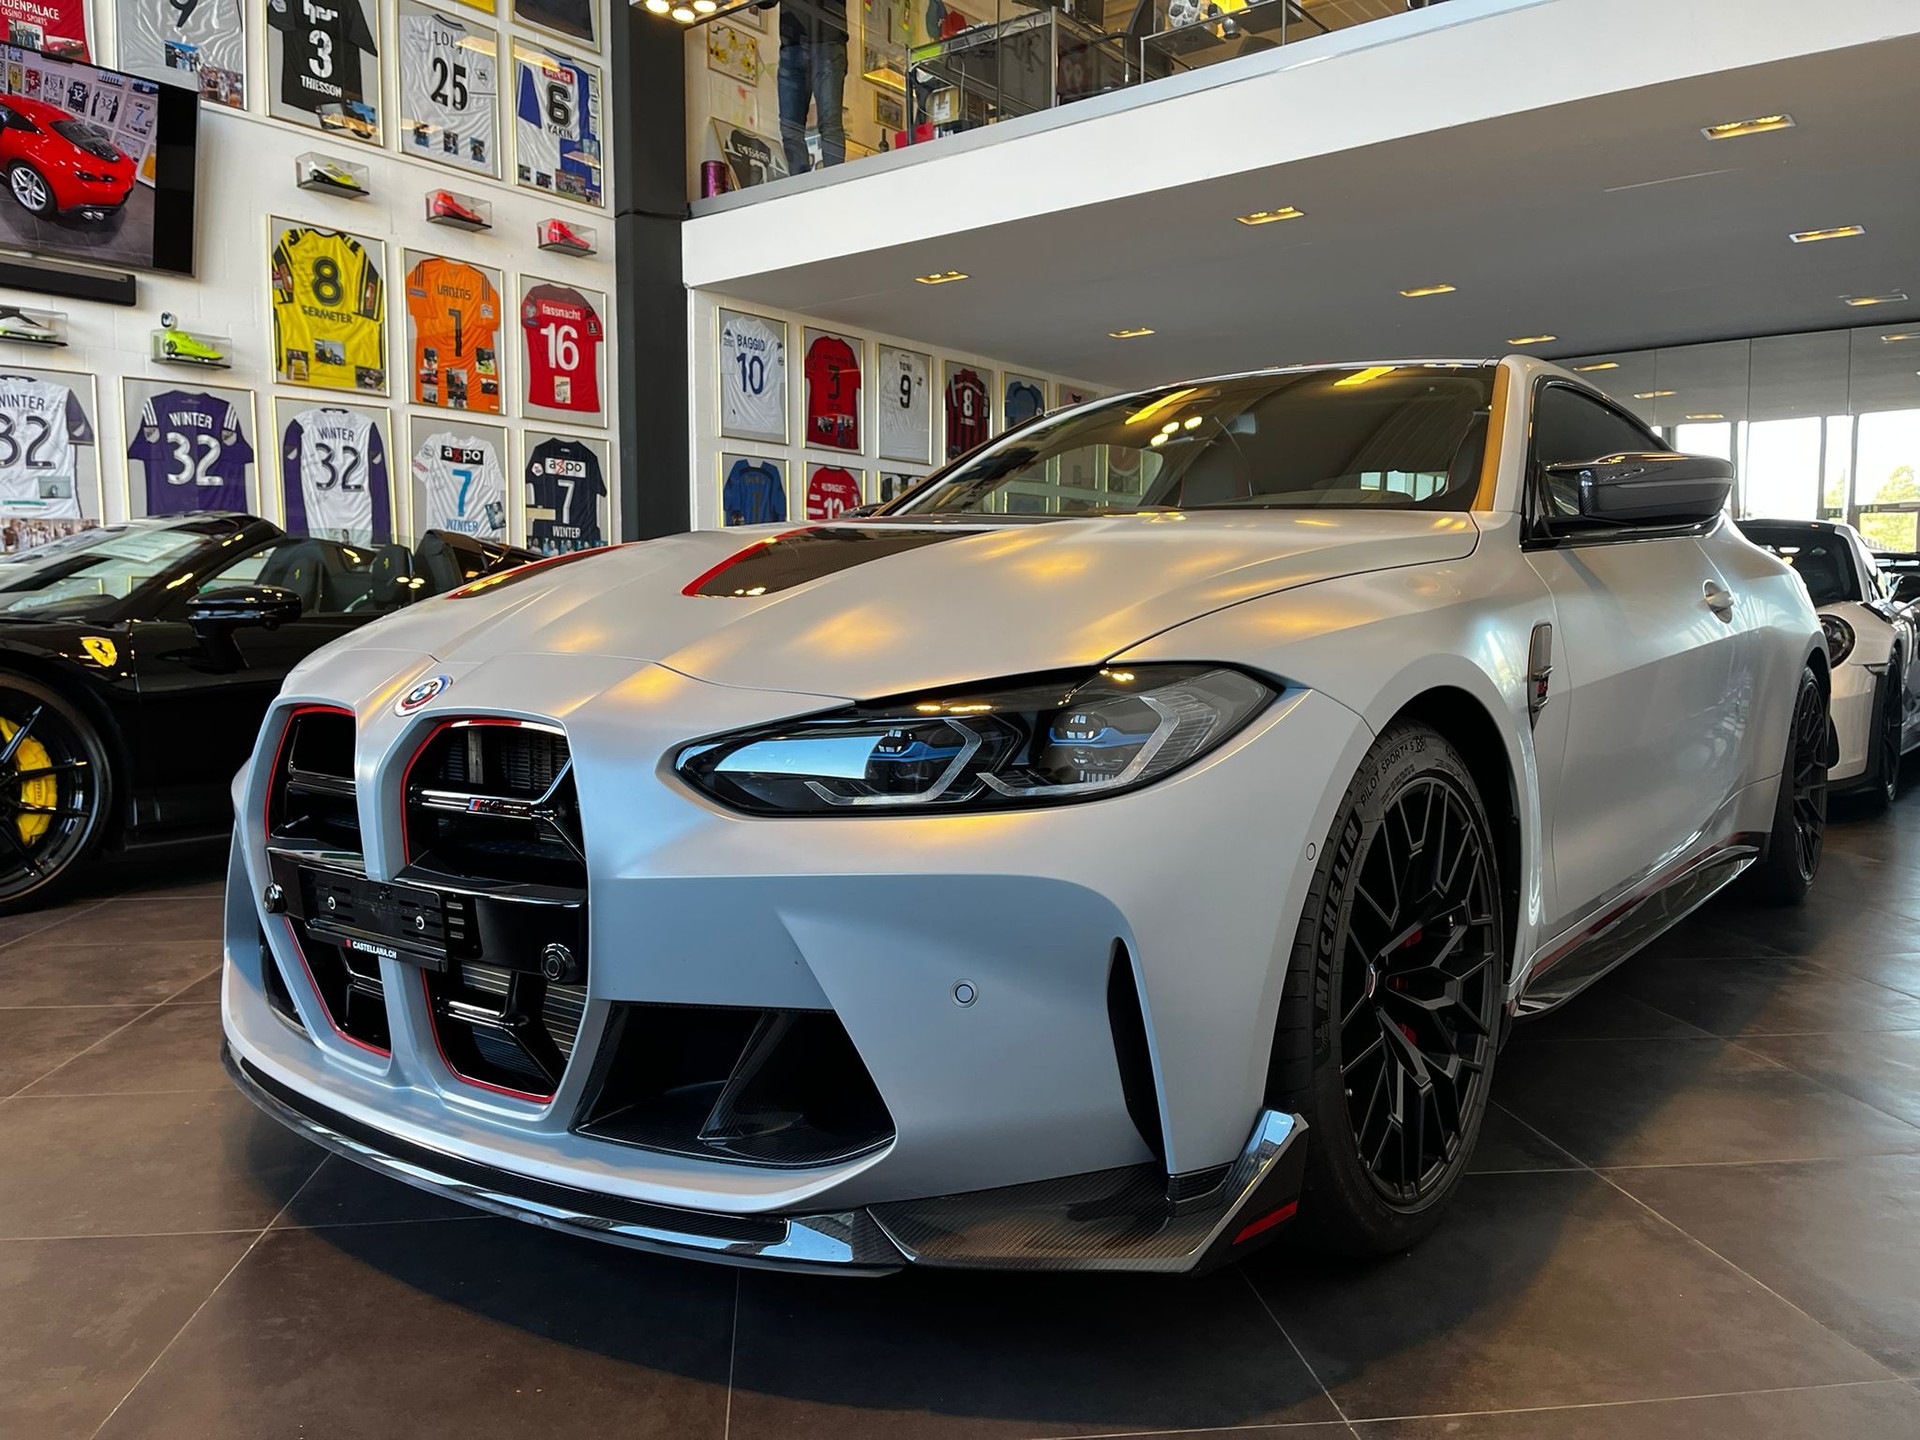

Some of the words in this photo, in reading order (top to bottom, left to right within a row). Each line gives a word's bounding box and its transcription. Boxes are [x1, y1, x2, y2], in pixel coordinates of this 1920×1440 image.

[1, 7, 22, 20] CASINO
[26, 14, 48, 27] SPORTS
[308, 29, 333, 79] 3
[71, 88, 83, 101] 32
[300, 74, 342, 98] THIESSON
[431, 57, 468, 111] 25
[100, 97, 112, 110] 32
[135, 108, 144, 121] 7
[547, 82, 572, 129] 6
[546, 122, 574, 140] YAKIN
[312, 256, 344, 307] 8
[448, 308, 462, 357] 1
[540, 322, 579, 371] 16
[737, 334, 765, 351] BAGGIO
[736, 352, 764, 394] 10
[900, 374, 911, 408] 9
[963, 389, 974, 417] 8
[168, 411, 213, 429] WINTER
[318, 427, 355, 441] WINTER
[0, 413, 56, 469] 32
[166, 432, 224, 486] 32
[315, 443, 364, 492] 32
[452, 469, 472, 517] 7
[558, 479, 575, 524] 7
[445, 518, 479, 532] WINTER
[552, 526, 580, 538] WINTER
[1361, 771, 1380, 807] PILOT
[1315, 819, 1359, 1012] MICHELIN
[352, 941, 397, 959] CASTELLANA.CH
